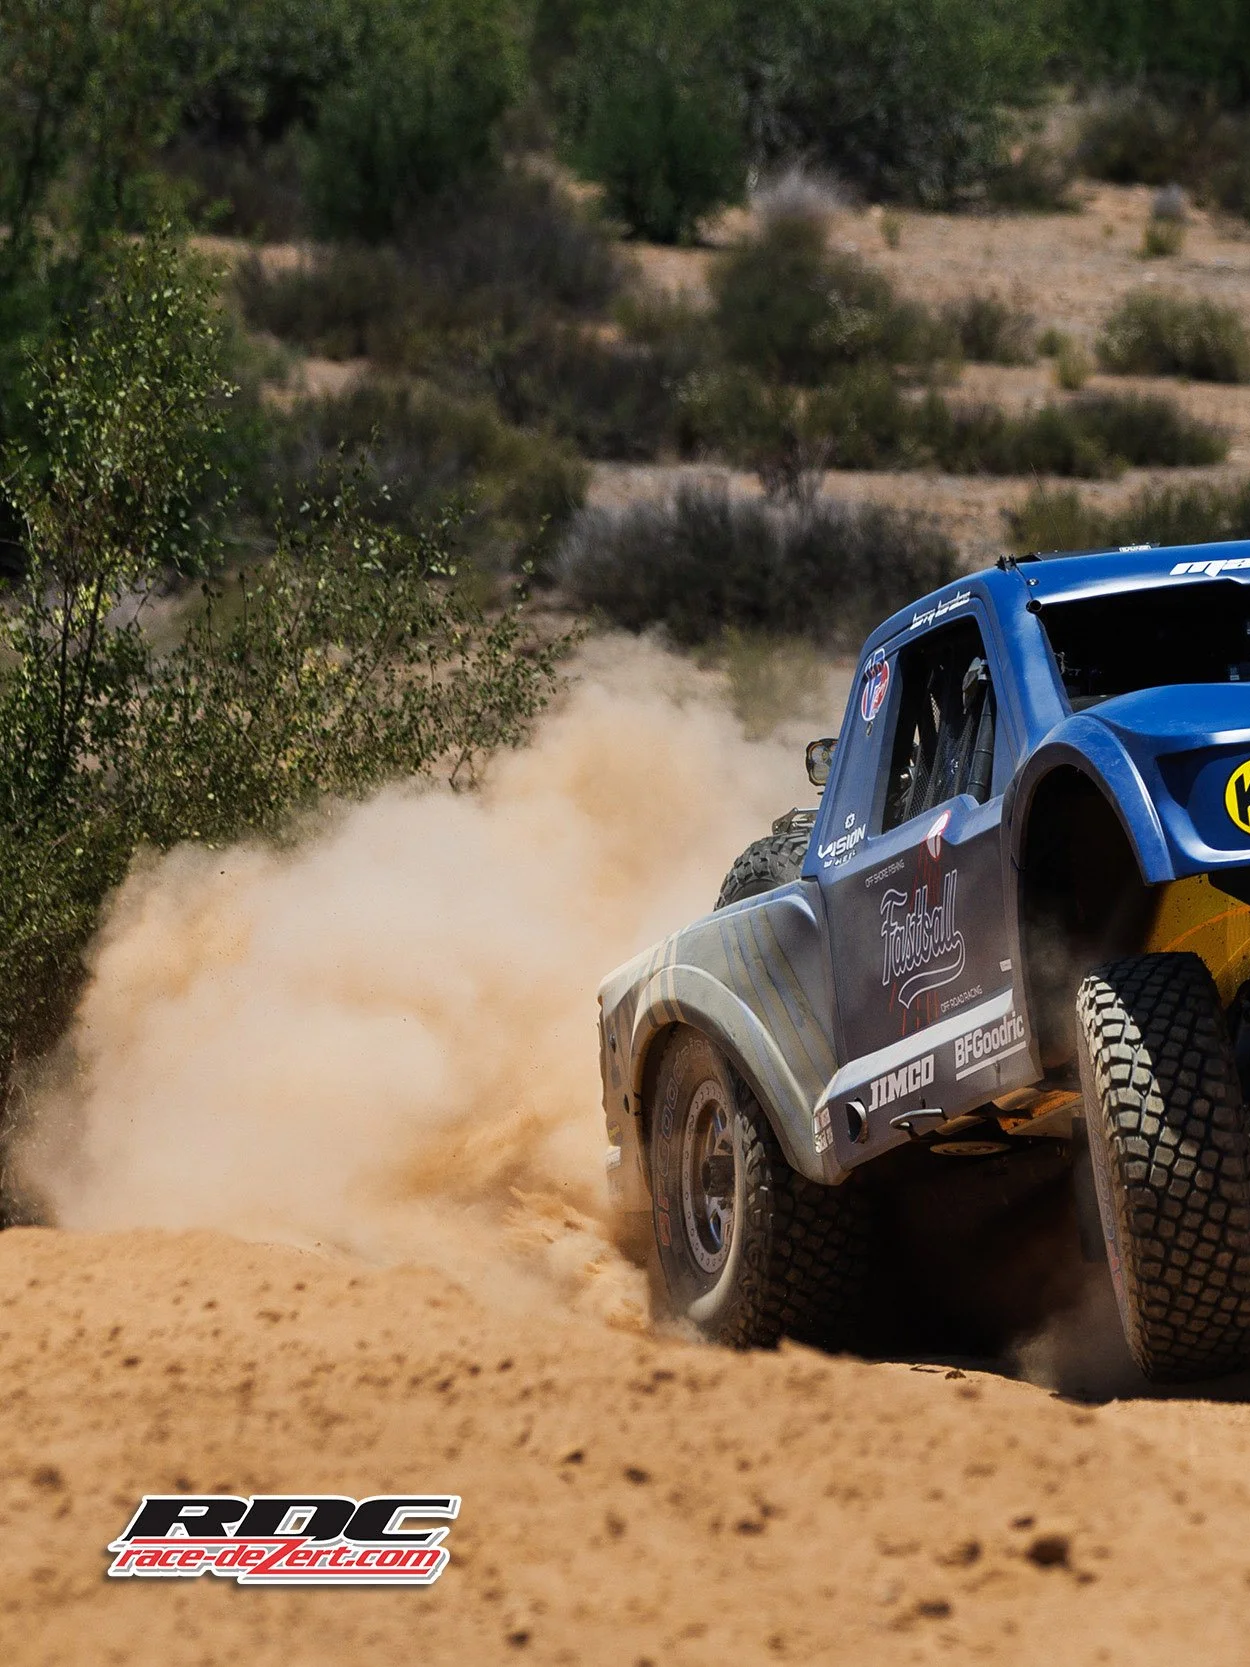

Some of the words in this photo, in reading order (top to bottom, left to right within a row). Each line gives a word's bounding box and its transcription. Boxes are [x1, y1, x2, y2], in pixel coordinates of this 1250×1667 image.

[818, 823, 866, 859] VISION
[881, 869, 964, 1006] Fastball
[868, 1054, 935, 1113] JIMCO
